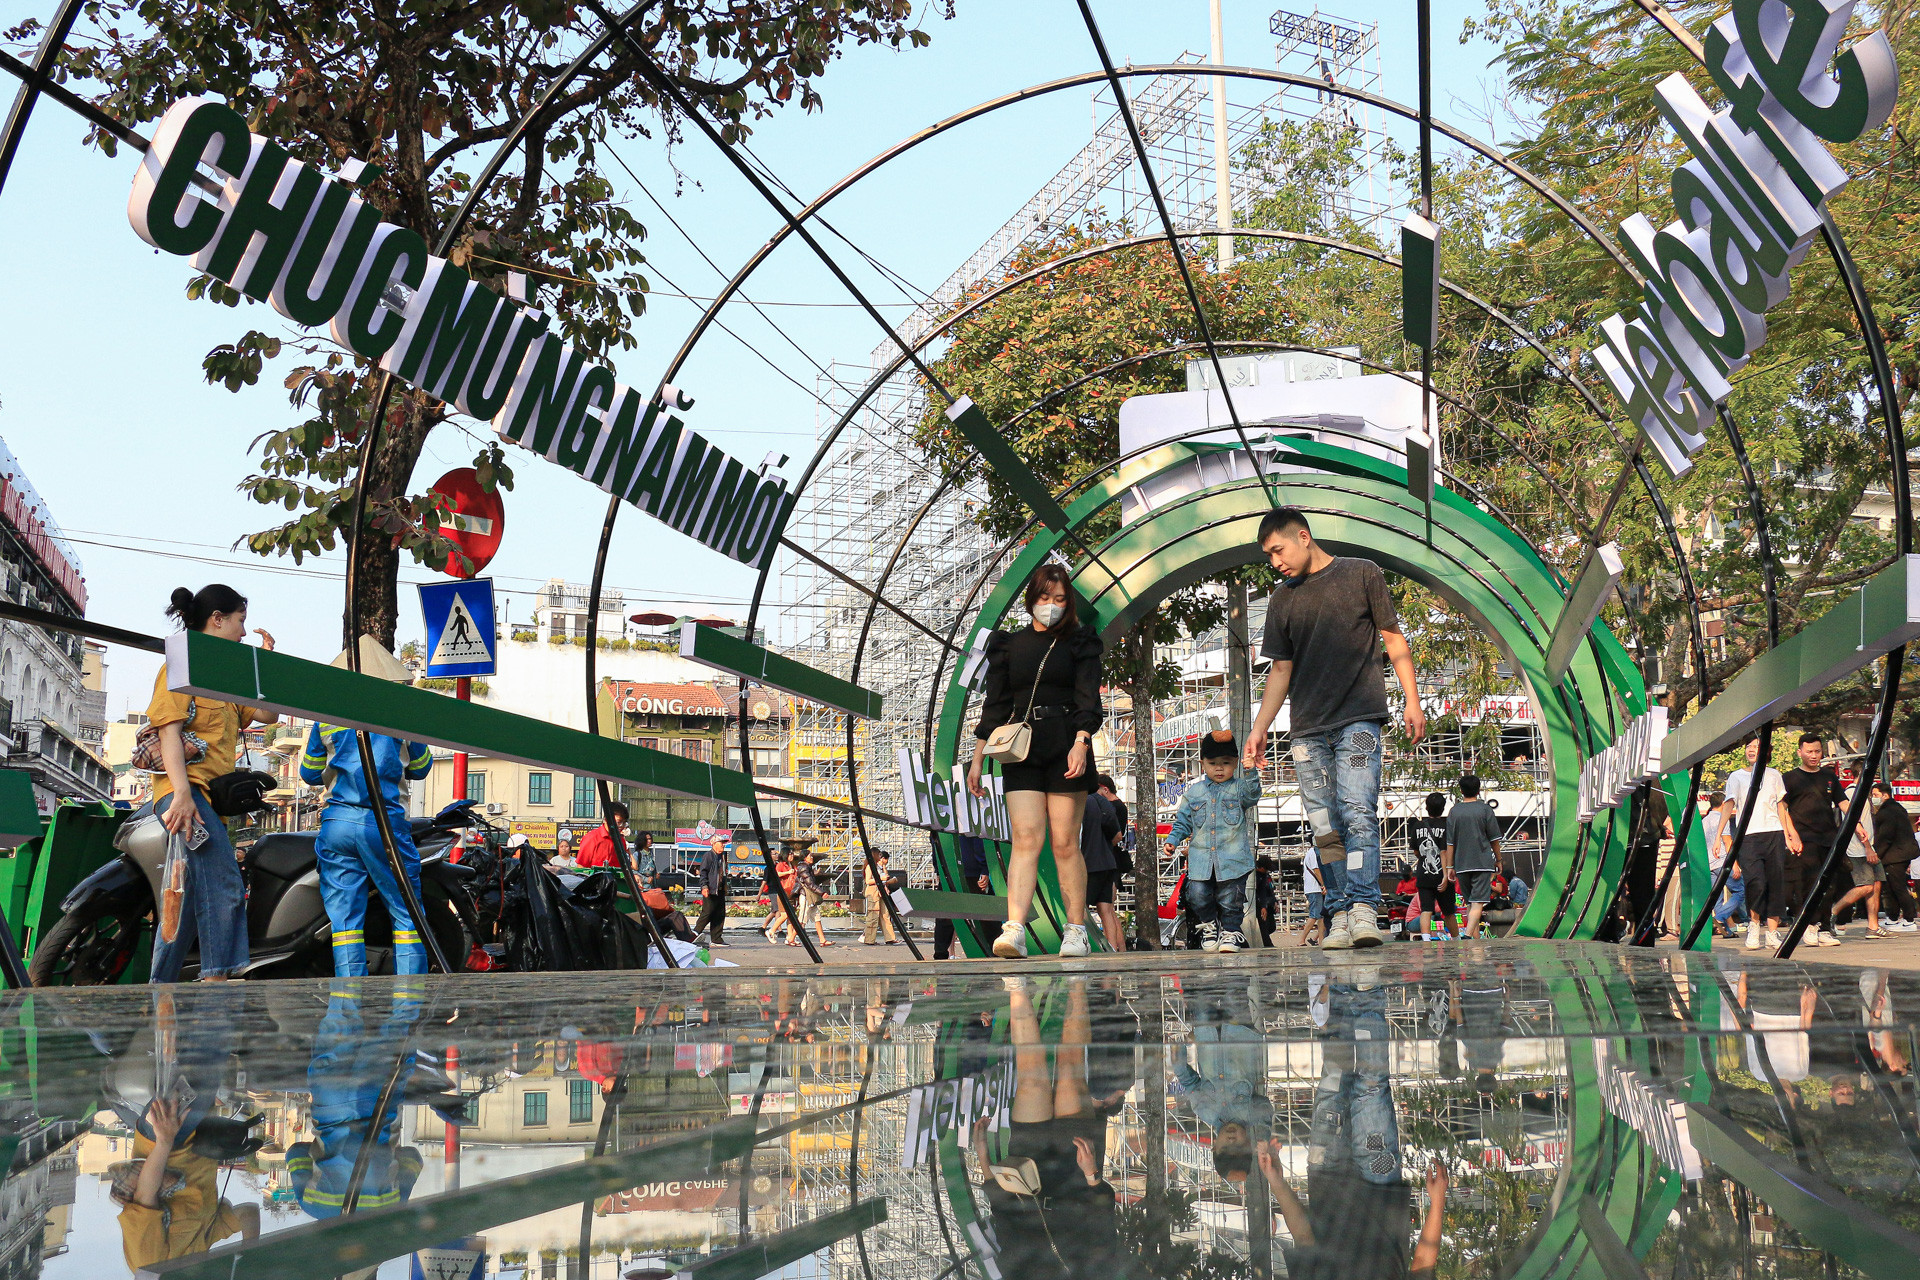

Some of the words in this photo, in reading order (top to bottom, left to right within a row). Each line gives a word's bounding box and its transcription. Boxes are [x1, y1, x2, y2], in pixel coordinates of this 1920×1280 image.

[128, 97, 428, 358] CHÚC
[584, 383, 725, 537] NĂM
[686, 706, 729, 716] CAPHE
[1891, 786, 1920, 795] TERI
